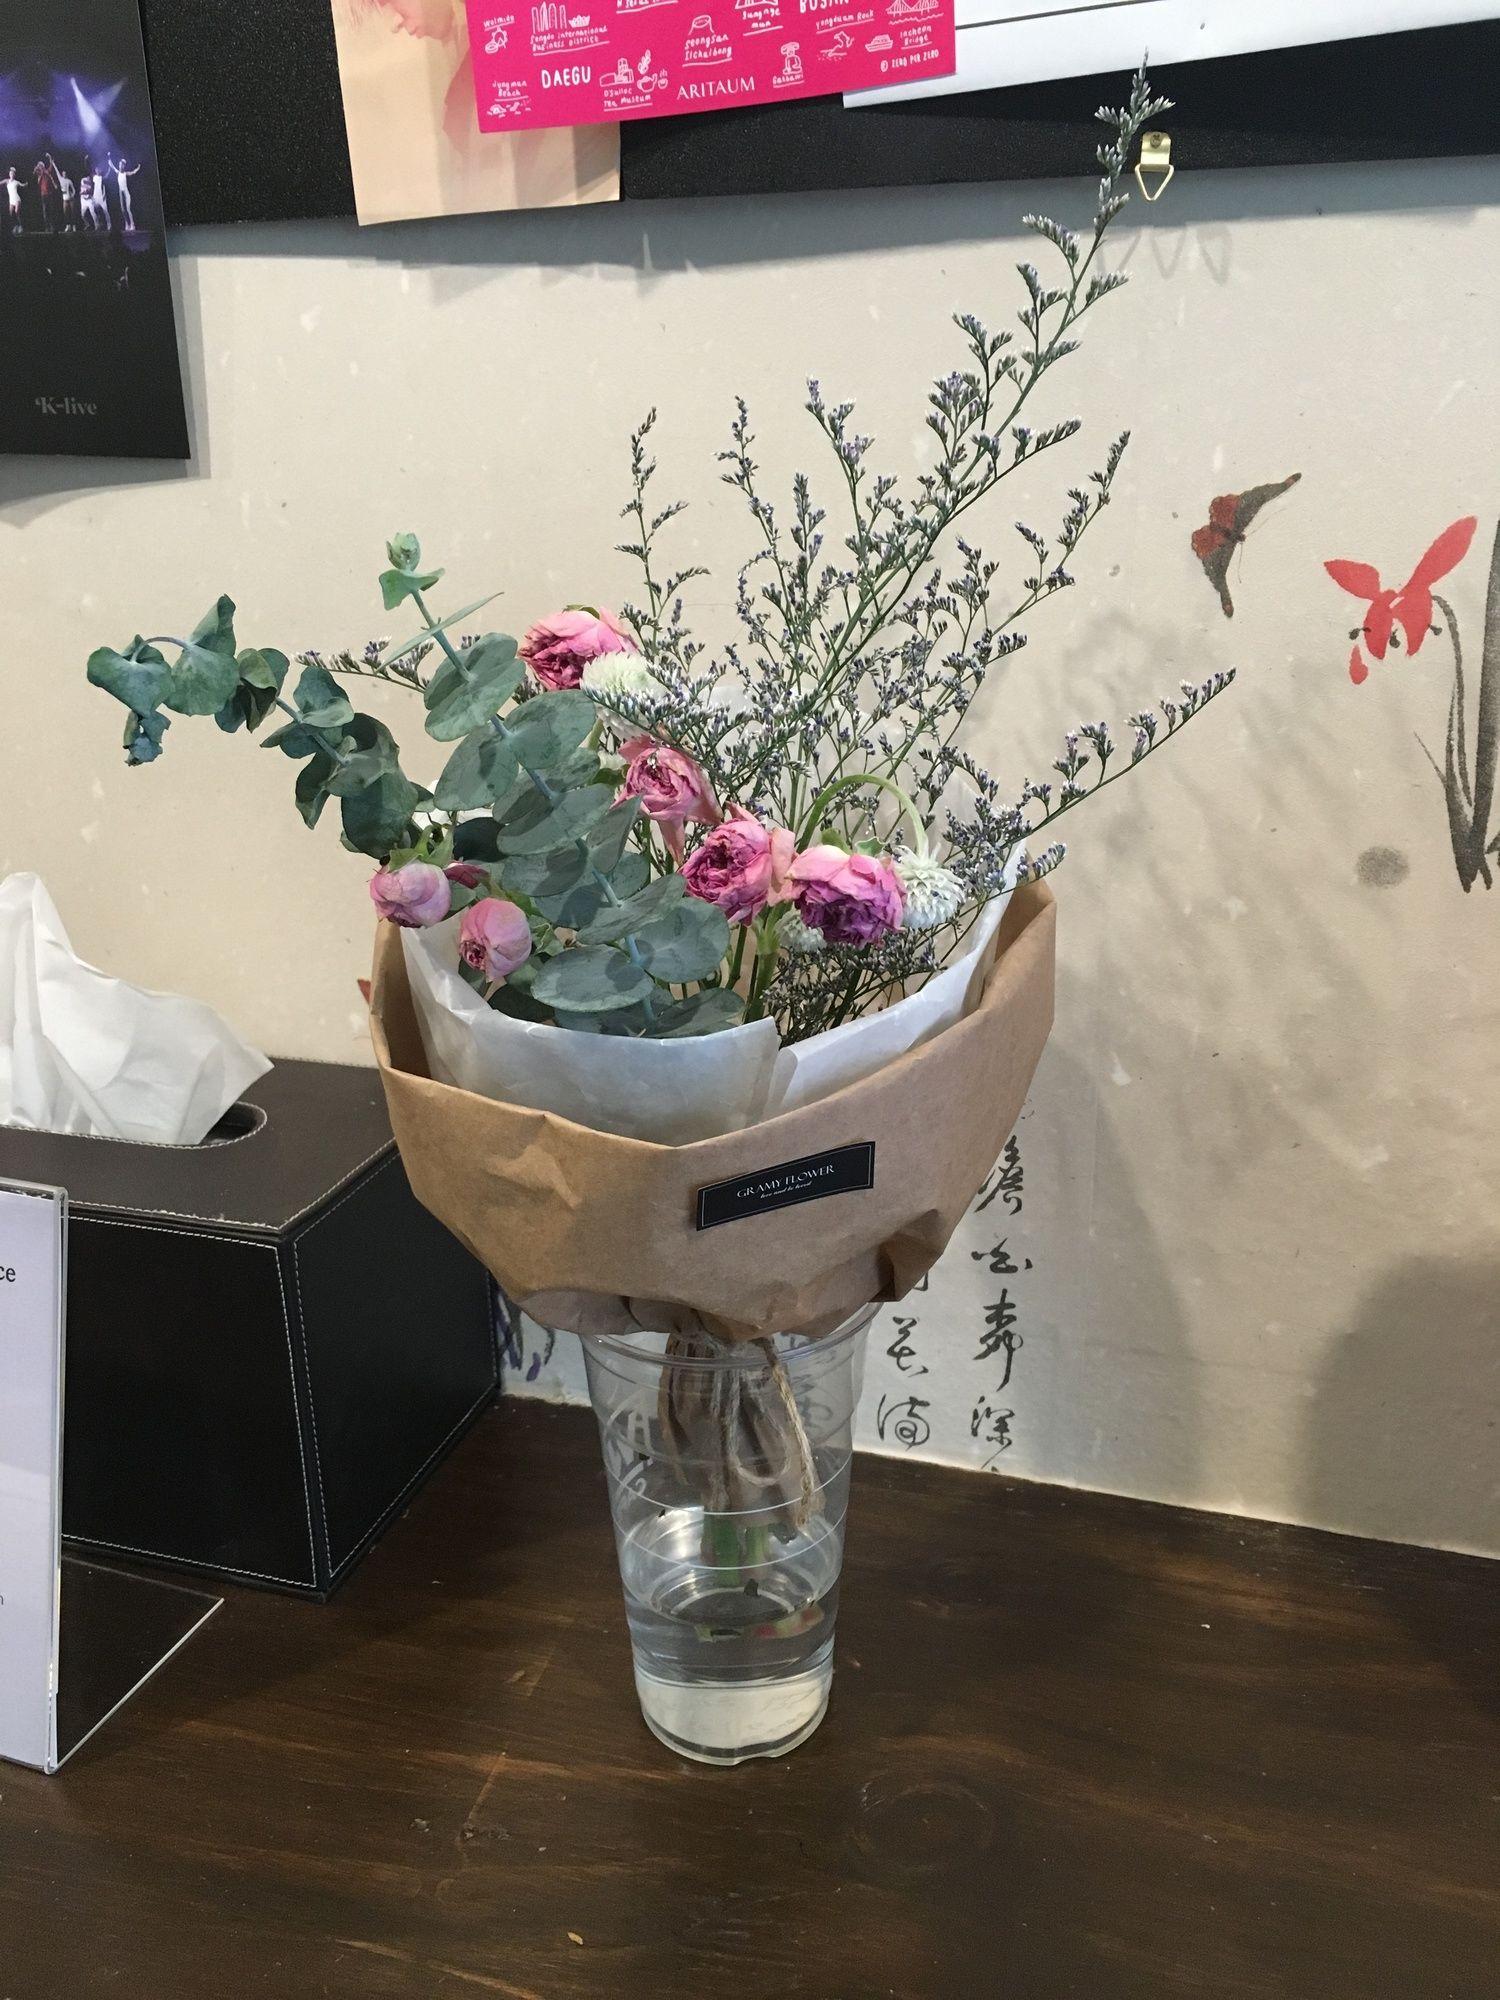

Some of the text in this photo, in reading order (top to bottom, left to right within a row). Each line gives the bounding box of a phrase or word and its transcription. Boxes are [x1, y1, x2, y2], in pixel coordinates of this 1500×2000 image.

[541, 66, 591, 89] DAEGU
[677, 76, 755, 99] ARITAUM
[34, 396, 98, 415] K-live
[737, 1165, 834, 1197] GRAMY FLOWER
